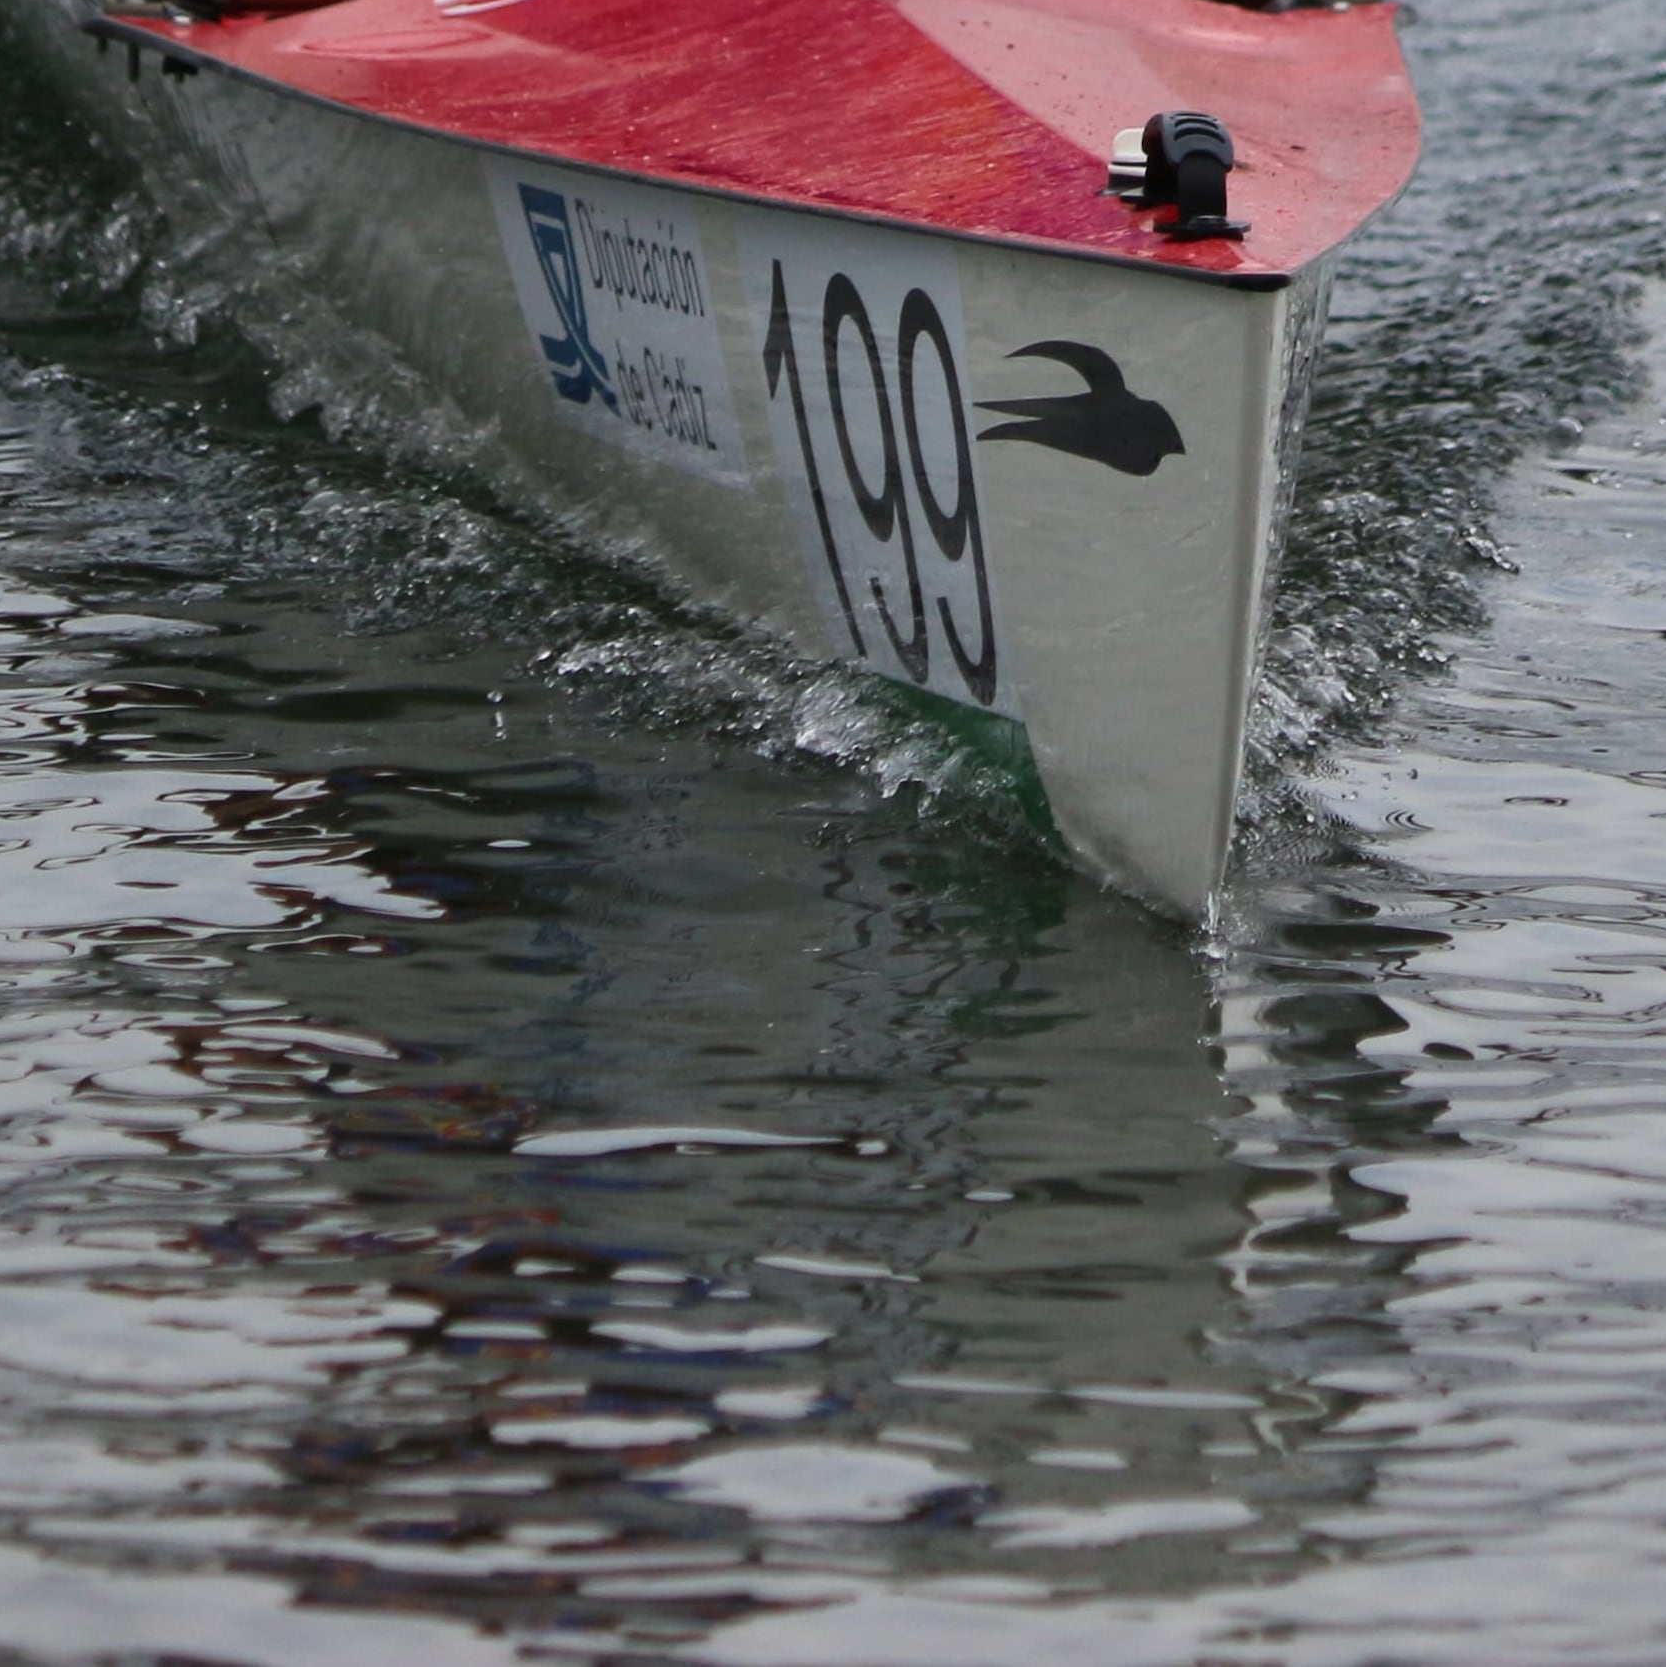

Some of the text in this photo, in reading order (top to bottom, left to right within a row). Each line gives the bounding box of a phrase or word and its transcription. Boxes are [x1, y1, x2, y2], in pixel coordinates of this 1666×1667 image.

[574, 197, 705, 314] Diputación
[615, 337, 718, 452] de Cádiz
[762, 257, 998, 707] 199
